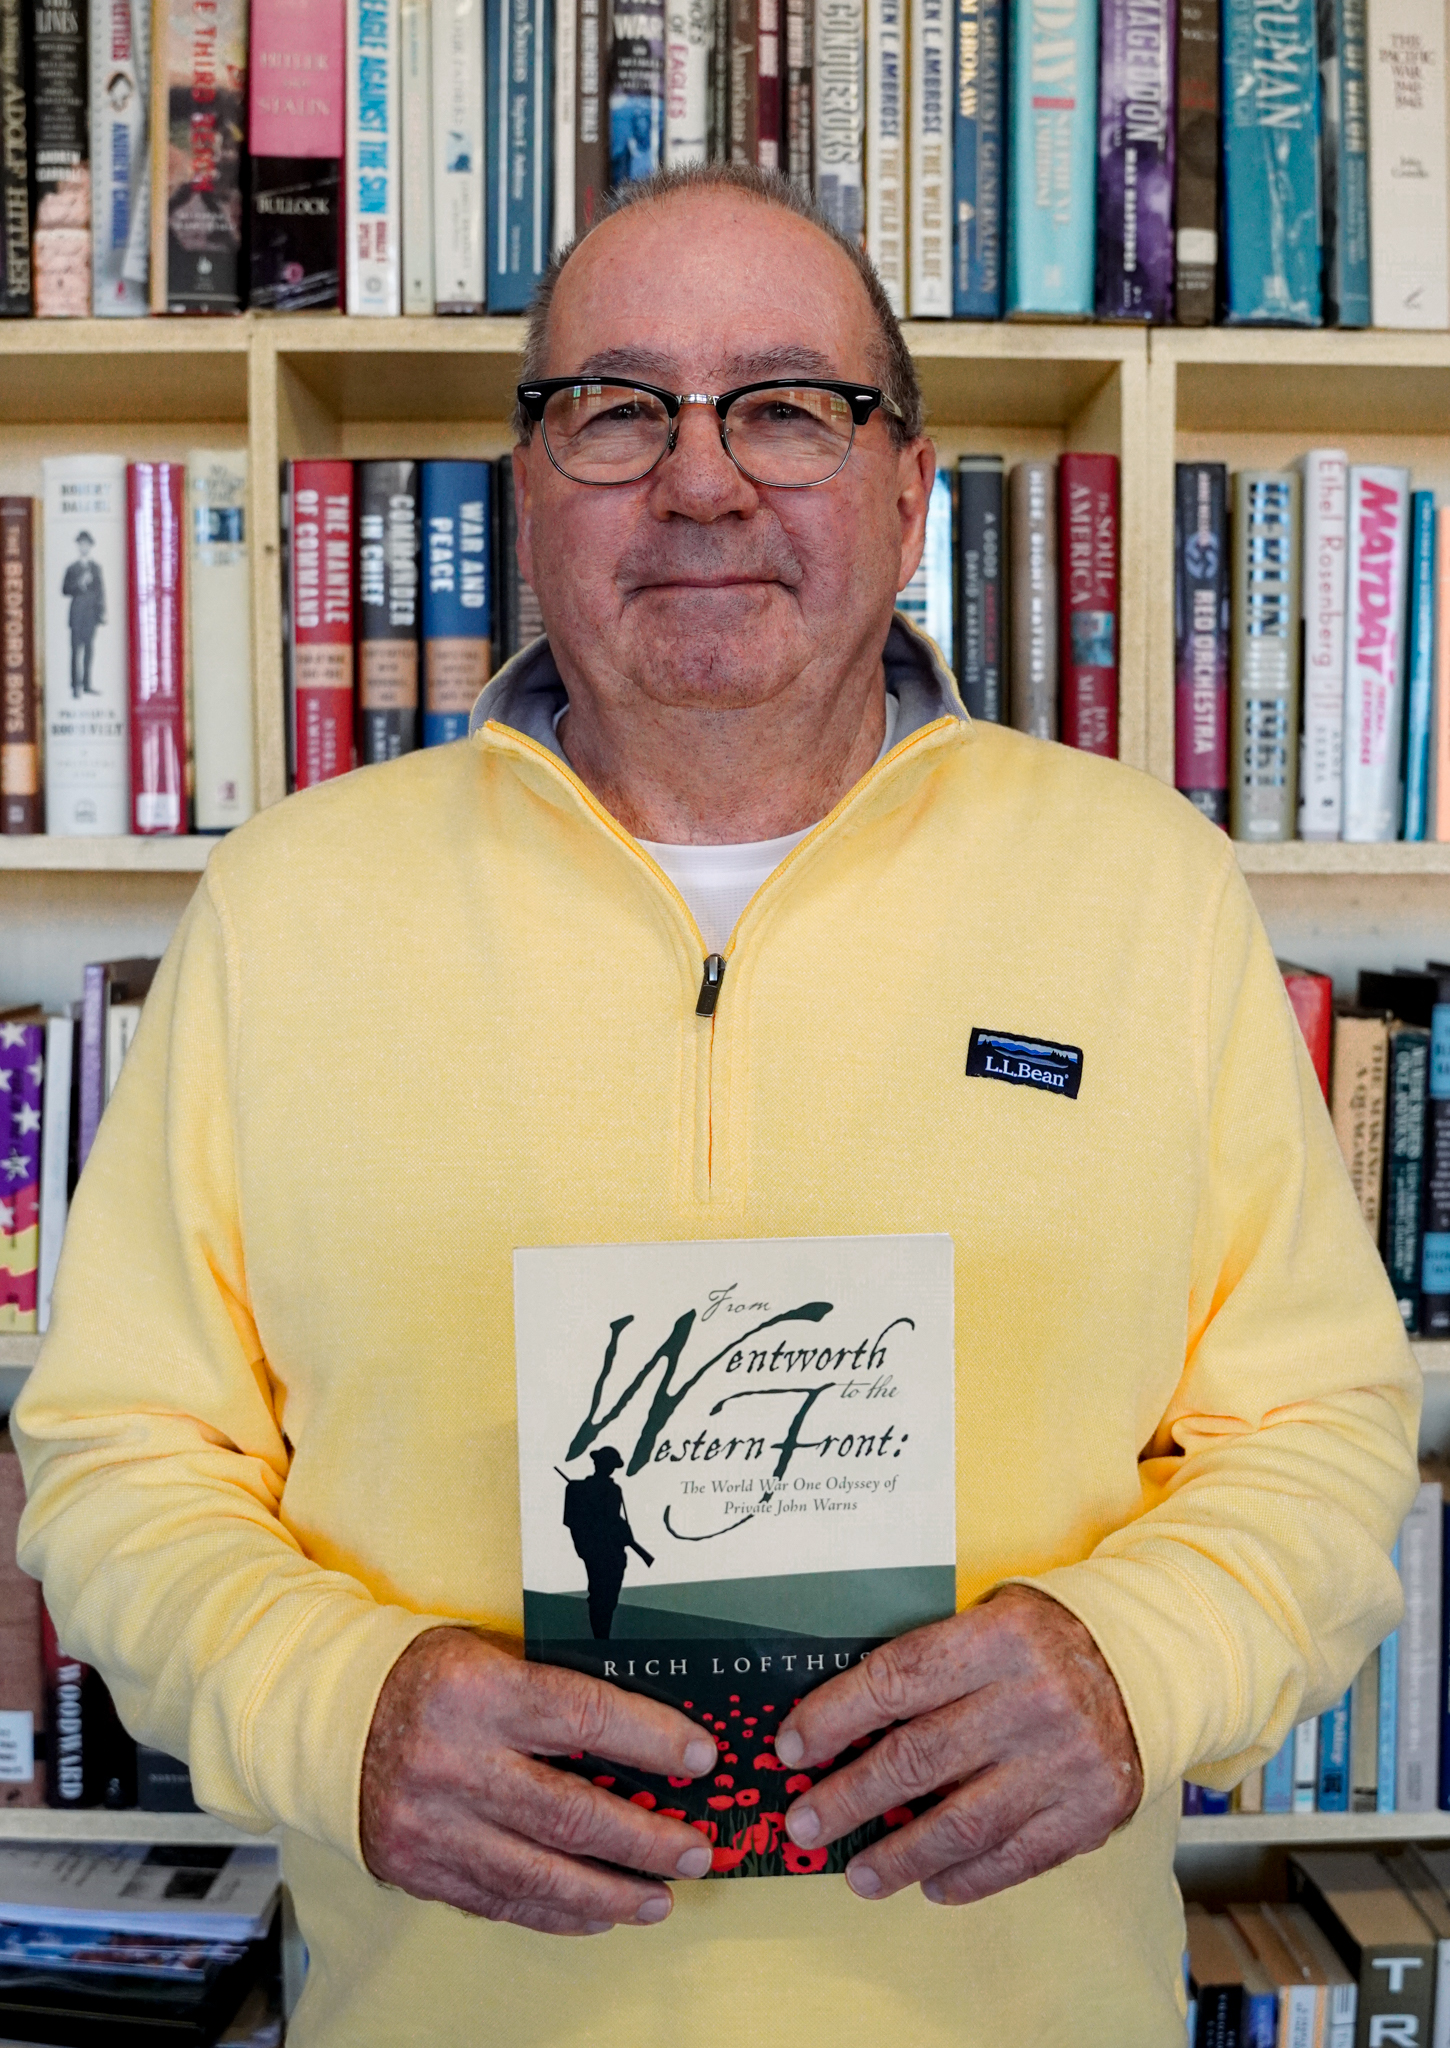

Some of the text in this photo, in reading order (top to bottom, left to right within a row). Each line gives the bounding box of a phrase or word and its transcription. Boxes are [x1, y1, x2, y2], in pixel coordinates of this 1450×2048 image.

[359, 55, 388, 133] AGAINST
[581, 17, 598, 95] NUREMBERG
[667, 45, 688, 119] EAGLES
[732, 38, 753, 142] Americans
[818, 3, 862, 164] CONQUERORS
[880, 51, 899, 138] AMBROSE
[924, 47, 942, 137] AMBROSE
[960, 21, 979, 121] BROKAW
[4, 82, 28, 179] ADOLF
[192, 26, 216, 191] THIRD REICH
[581, 97, 598, 143] TRIALS
[359, 141, 388, 170] THE
[359, 175, 388, 214] SUN
[880, 148, 899, 183] THE
[924, 144, 942, 178] THE
[3, 187, 31, 297] HITLER
[256, 196, 330, 215] BULLOCK
[924, 185, 942, 229] WILD
[924, 236, 942, 281] BLUE
[296, 489, 319, 628] OF COMMAND
[324, 493, 350, 624] THE MANTLE
[360, 514, 384, 606] IN CHIEF
[389, 494, 415, 626] COMMANDER
[429, 517, 455, 602] PEACE
[460, 502, 484, 608] WAR AND
[1069, 482, 1093, 605] AMERICA
[1096, 516, 1115, 579] SOUL
[1247, 481, 1291, 638] BERLIN
[1312, 459, 1343, 667] Ethel Rosenberg
[1356, 479, 1399, 676] MAYDAY
[5, 561, 24, 668] BEDFORD
[5, 673, 24, 733] BOYS
[1193, 589, 1217, 754] RED ORCHESTRA
[304, 699, 320, 787] HAMILTO
[1245, 699, 1288, 787] 1961
[702, 1283, 771, 1321] From
[840, 1374, 899, 1399] to the
[680, 1475, 900, 1497] The World War One Odyssey of
[724, 1498, 859, 1516] Private John Warns
[603, 1658, 689, 1677] RICH
[56, 1664, 84, 1799] WOODWARD
